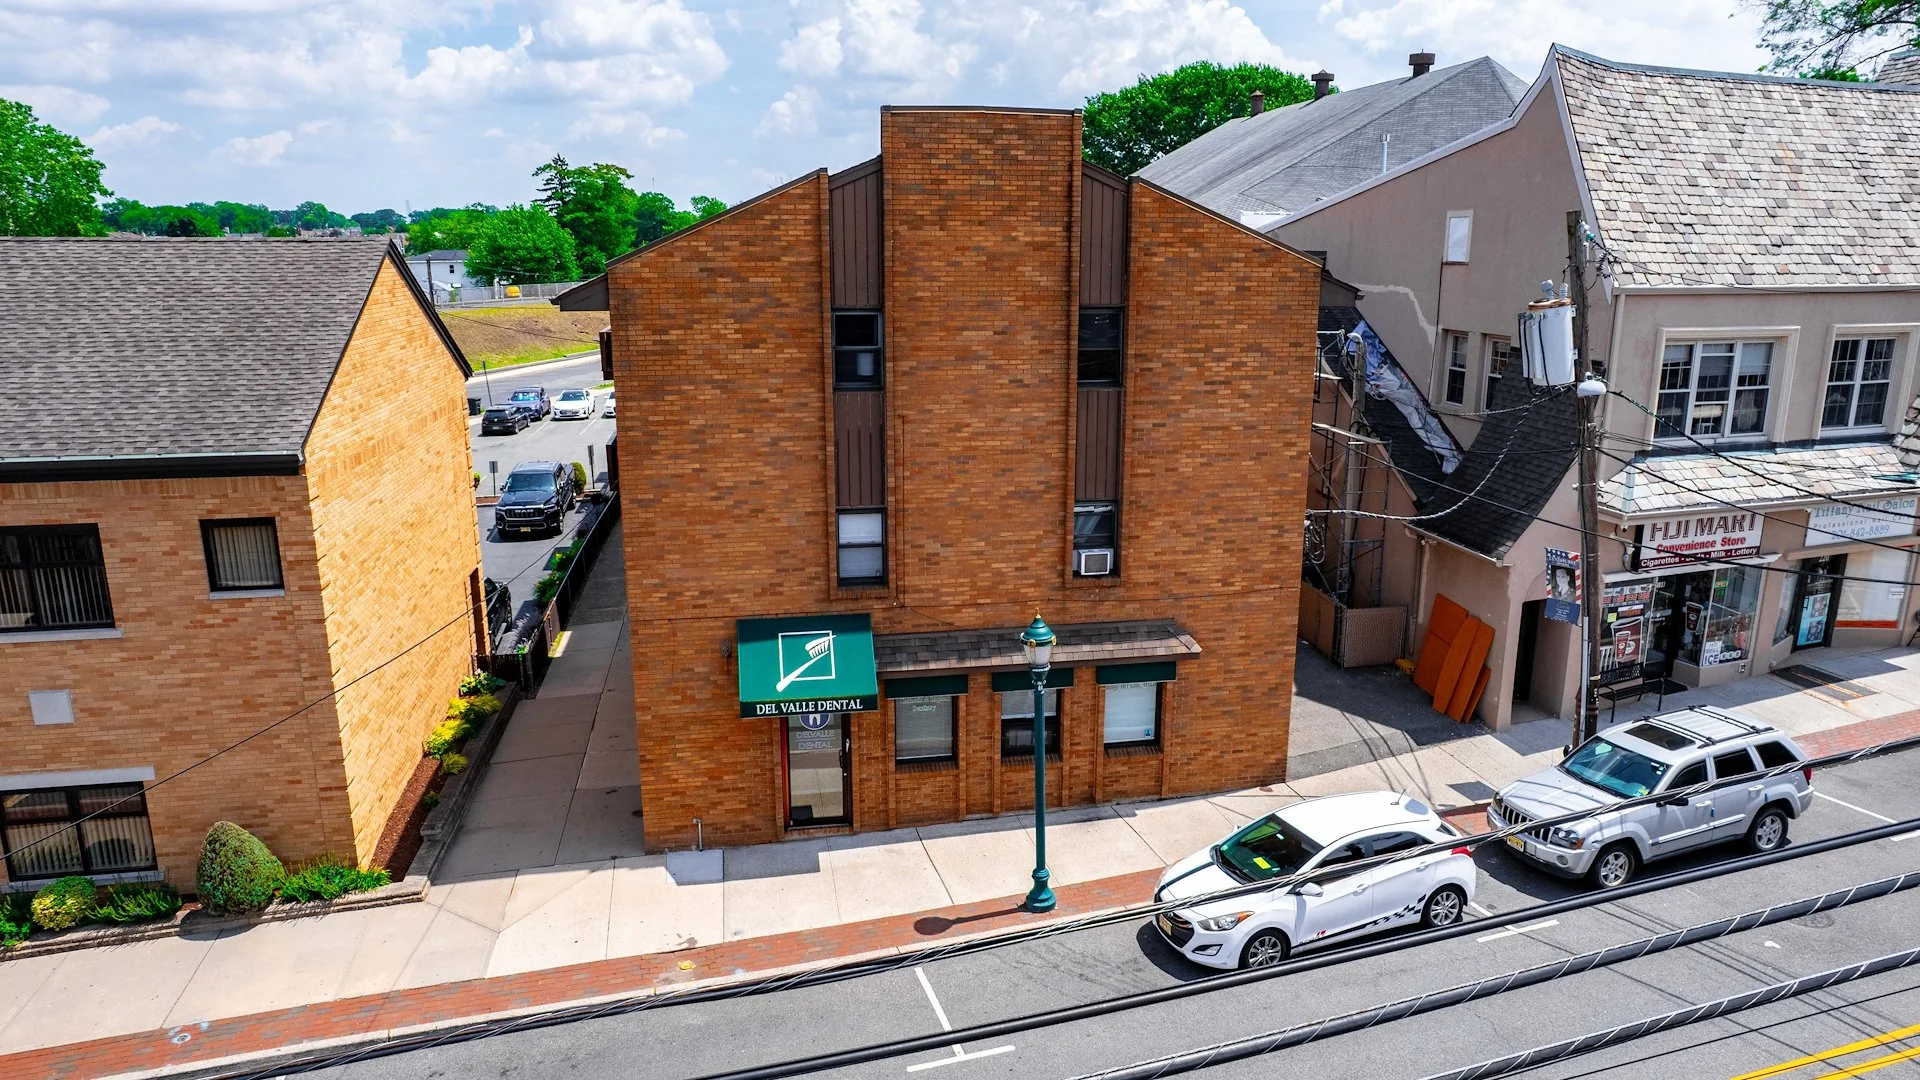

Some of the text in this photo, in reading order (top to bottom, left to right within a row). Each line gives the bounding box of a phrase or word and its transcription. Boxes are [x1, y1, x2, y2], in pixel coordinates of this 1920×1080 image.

[1814, 504, 1852, 518] Tiffany
[1883, 498, 1915, 510] Salon
[1656, 536, 1746, 554] Convenience Store
[1641, 556, 1680, 567] Cigarettes
[1710, 549, 1726, 558] Milk
[1731, 547, 1758, 556] Lottery
[1704, 653, 1719, 665] ICE
[756, 699, 863, 715] DEL VALLE DENTAL
[798, 741, 833, 750] DENTAL
